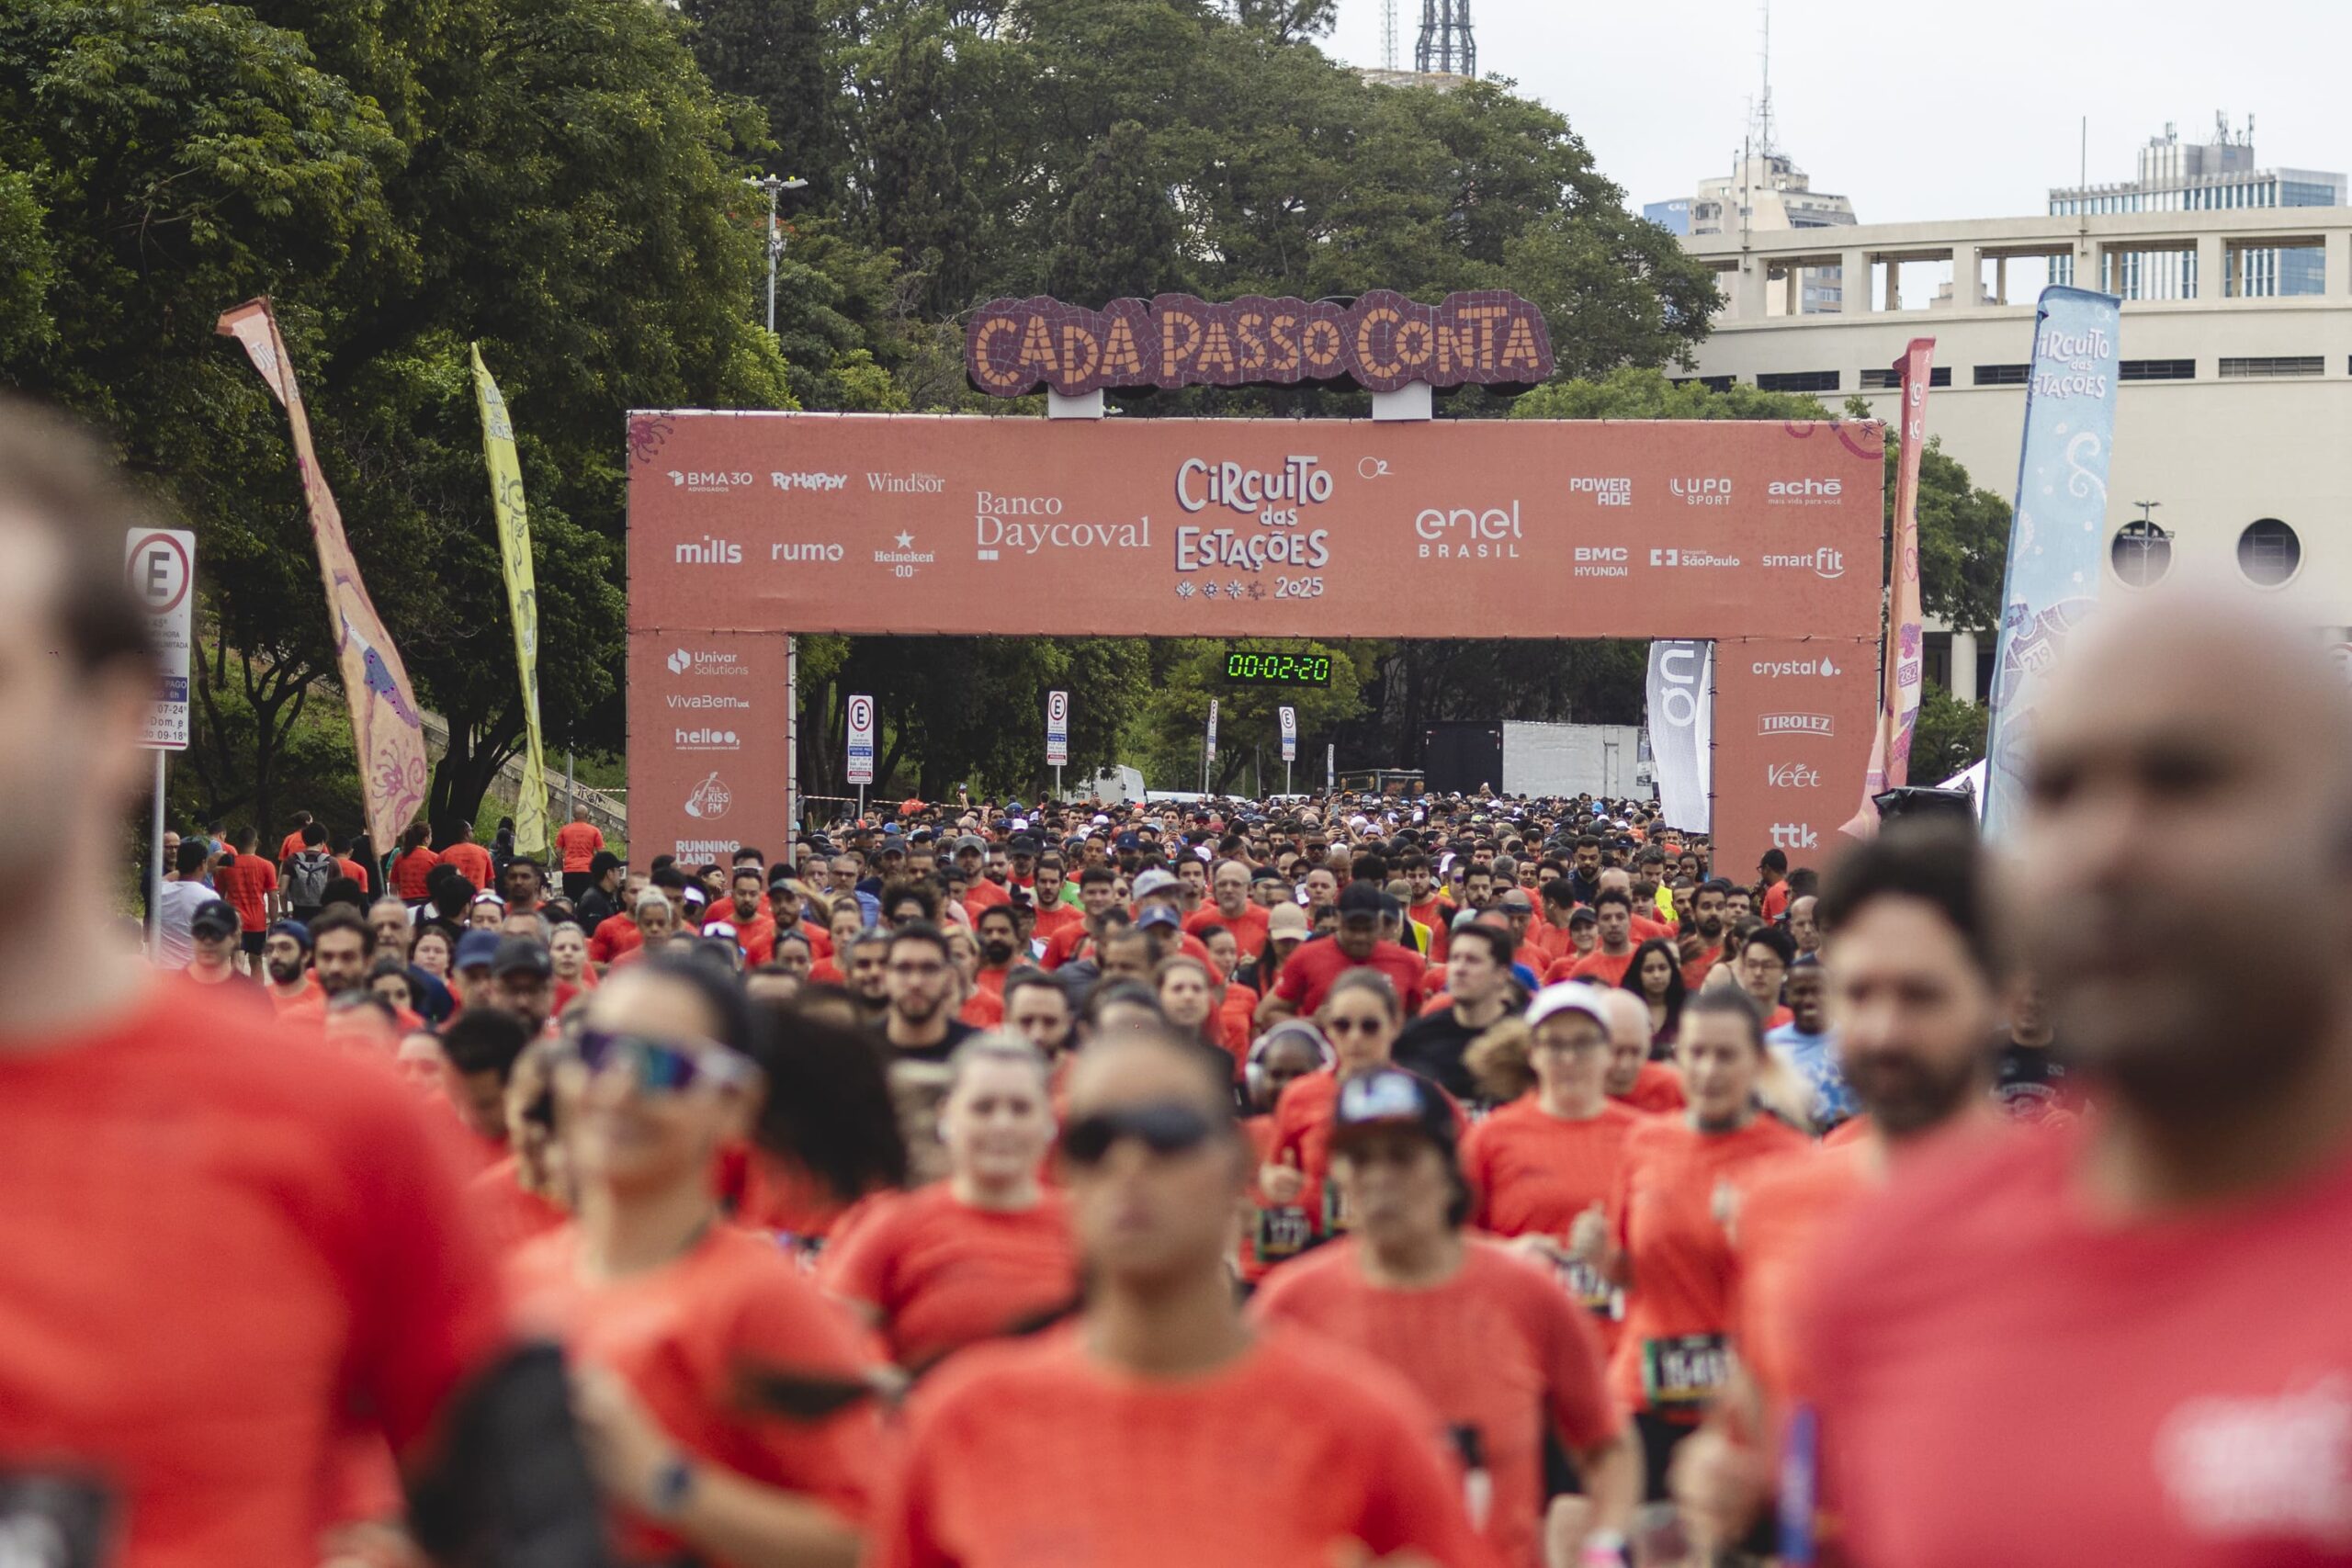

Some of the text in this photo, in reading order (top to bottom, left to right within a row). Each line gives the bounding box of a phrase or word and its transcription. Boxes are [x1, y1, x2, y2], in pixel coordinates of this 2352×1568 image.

[976, 306, 1539, 386] CADA PASSO CONTA
[2069, 359, 2094, 371] das
[2031, 372, 2108, 400] STAÇÕES
[866, 472, 945, 493] Windsor
[1569, 478, 1631, 492] POWER
[1670, 478, 1732, 497] LUPO
[976, 491, 1063, 515] Banco
[1597, 492, 1631, 505] ADE
[1687, 495, 1732, 505] SPORT
[1260, 503, 1298, 526] das
[1415, 499, 1523, 540] enel
[975, 514, 1152, 555] Daycoval
[675, 535, 742, 564] mills
[771, 543, 844, 561] rumo
[1176, 525, 1330, 572] ESTAÇÕES
[1419, 544, 1520, 558] BRASIL
[1574, 547, 1628, 561] BMC
[874, 551, 934, 563] Heineken
[1762, 553, 1813, 567] smart
[147, 551, 170, 597] E
[1574, 566, 1628, 577] HYUNDAI
[1274, 576, 1324, 599] 2025
[695, 651, 737, 663] Univar
[695, 663, 749, 675] Solutions
[1227, 654, 1329, 681] 00:02:20
[1752, 660, 1816, 678] crystal
[1899, 665, 1917, 682] 282
[666, 694, 737, 708] VivaBem
[1054, 699, 1061, 715] E
[856, 705, 865, 724] E
[1762, 716, 1830, 731] TIROLEZ
[707, 792, 729, 803] KISS
[707, 803, 722, 814] FM
[1770, 823, 1817, 848] ttk
[675, 840, 741, 852] RUNNING
[675, 852, 716, 865] LAND
